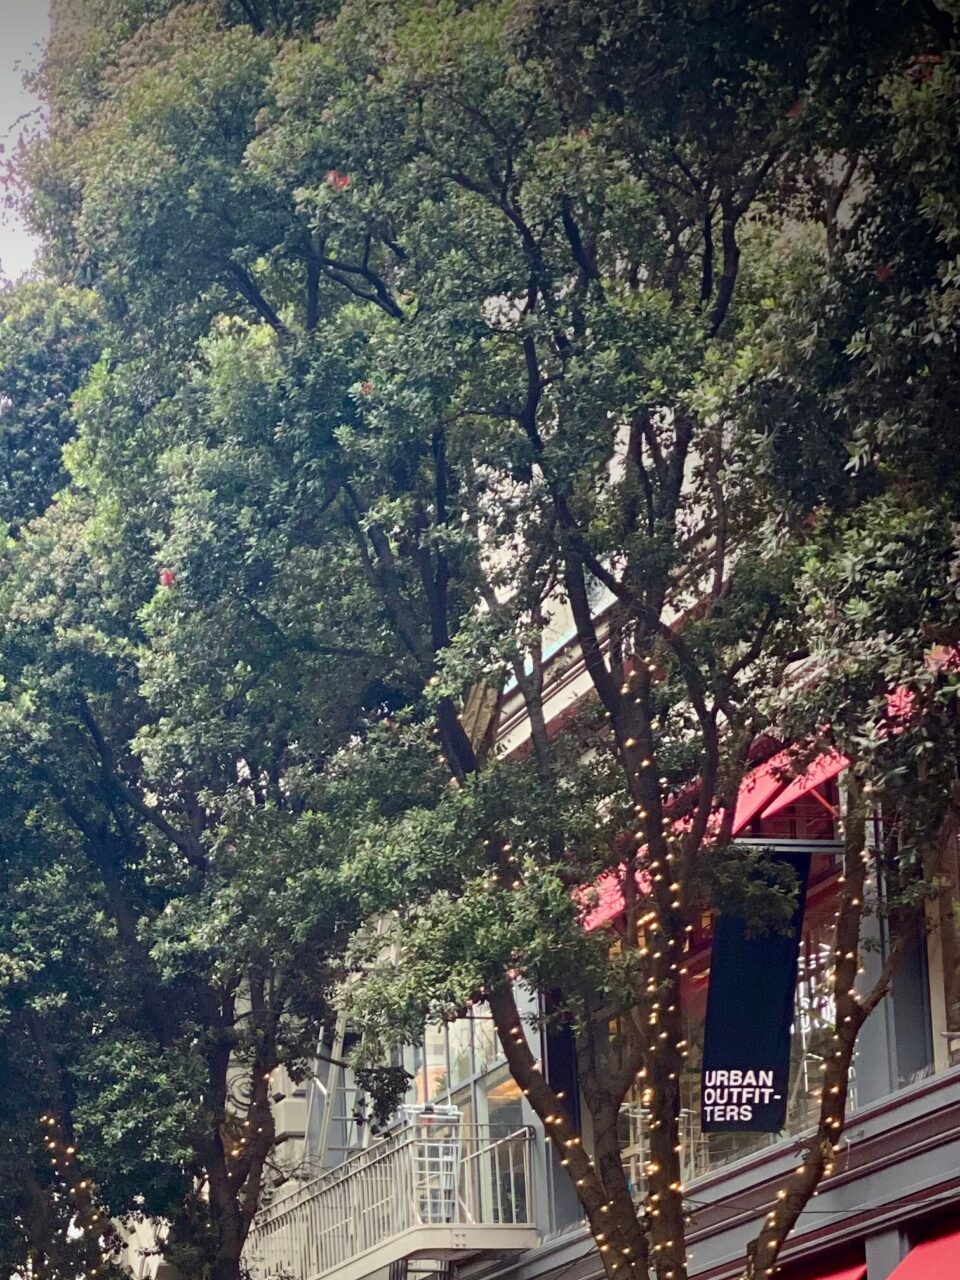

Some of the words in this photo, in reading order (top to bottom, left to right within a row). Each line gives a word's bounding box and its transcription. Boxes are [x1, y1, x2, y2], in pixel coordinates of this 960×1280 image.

[705, 1070, 773, 1086] URBAN
[704, 1088, 781, 1104] OUTFIT-
[704, 1105, 752, 1121] TERS
